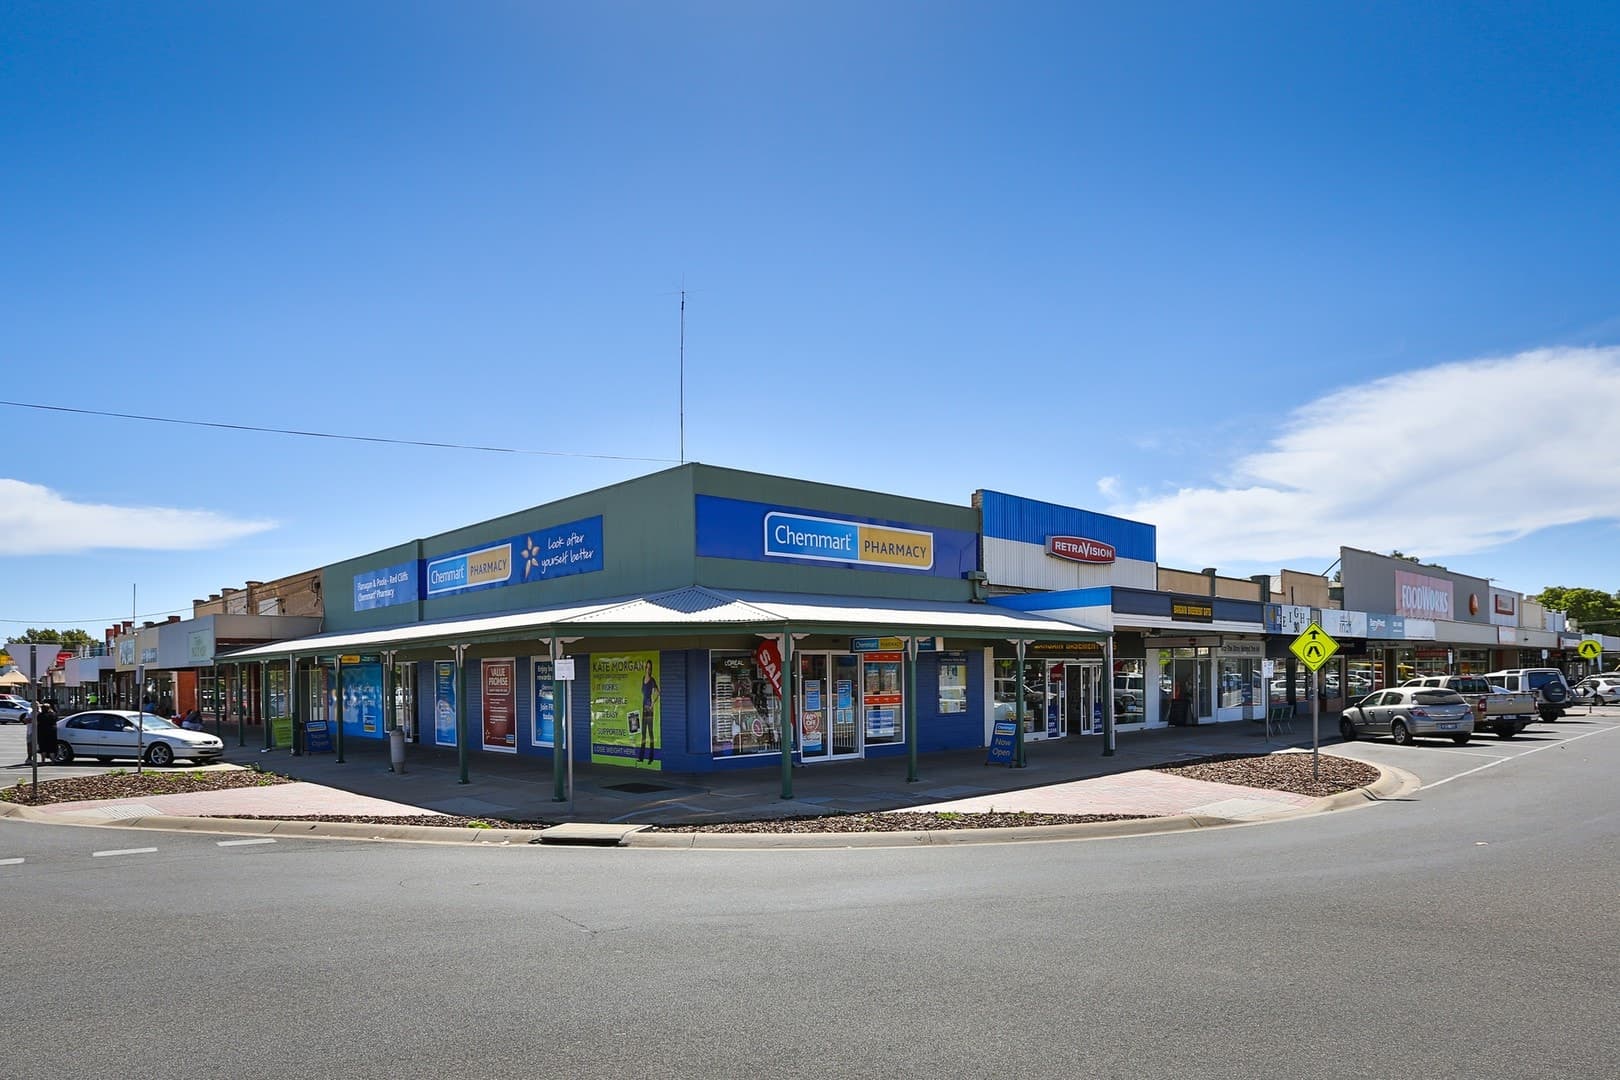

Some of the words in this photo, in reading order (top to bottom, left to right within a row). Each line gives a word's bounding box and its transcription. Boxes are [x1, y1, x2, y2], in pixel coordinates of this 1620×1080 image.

[567, 532, 585, 547] after
[775, 525, 851, 551] Chemmart
[864, 539, 927, 559] PHARMACY
[541, 550, 569, 574] yourself
[570, 548, 594, 563] better
[431, 566, 465, 585] Chemmart
[470, 559, 507, 575] PHARMACY
[592, 661, 610, 672] KATE
[612, 660, 645, 671] MORGAN
[760, 649, 783, 697] SAL
[995, 738, 1011, 746] Now
[992, 748, 1011, 757] Open
